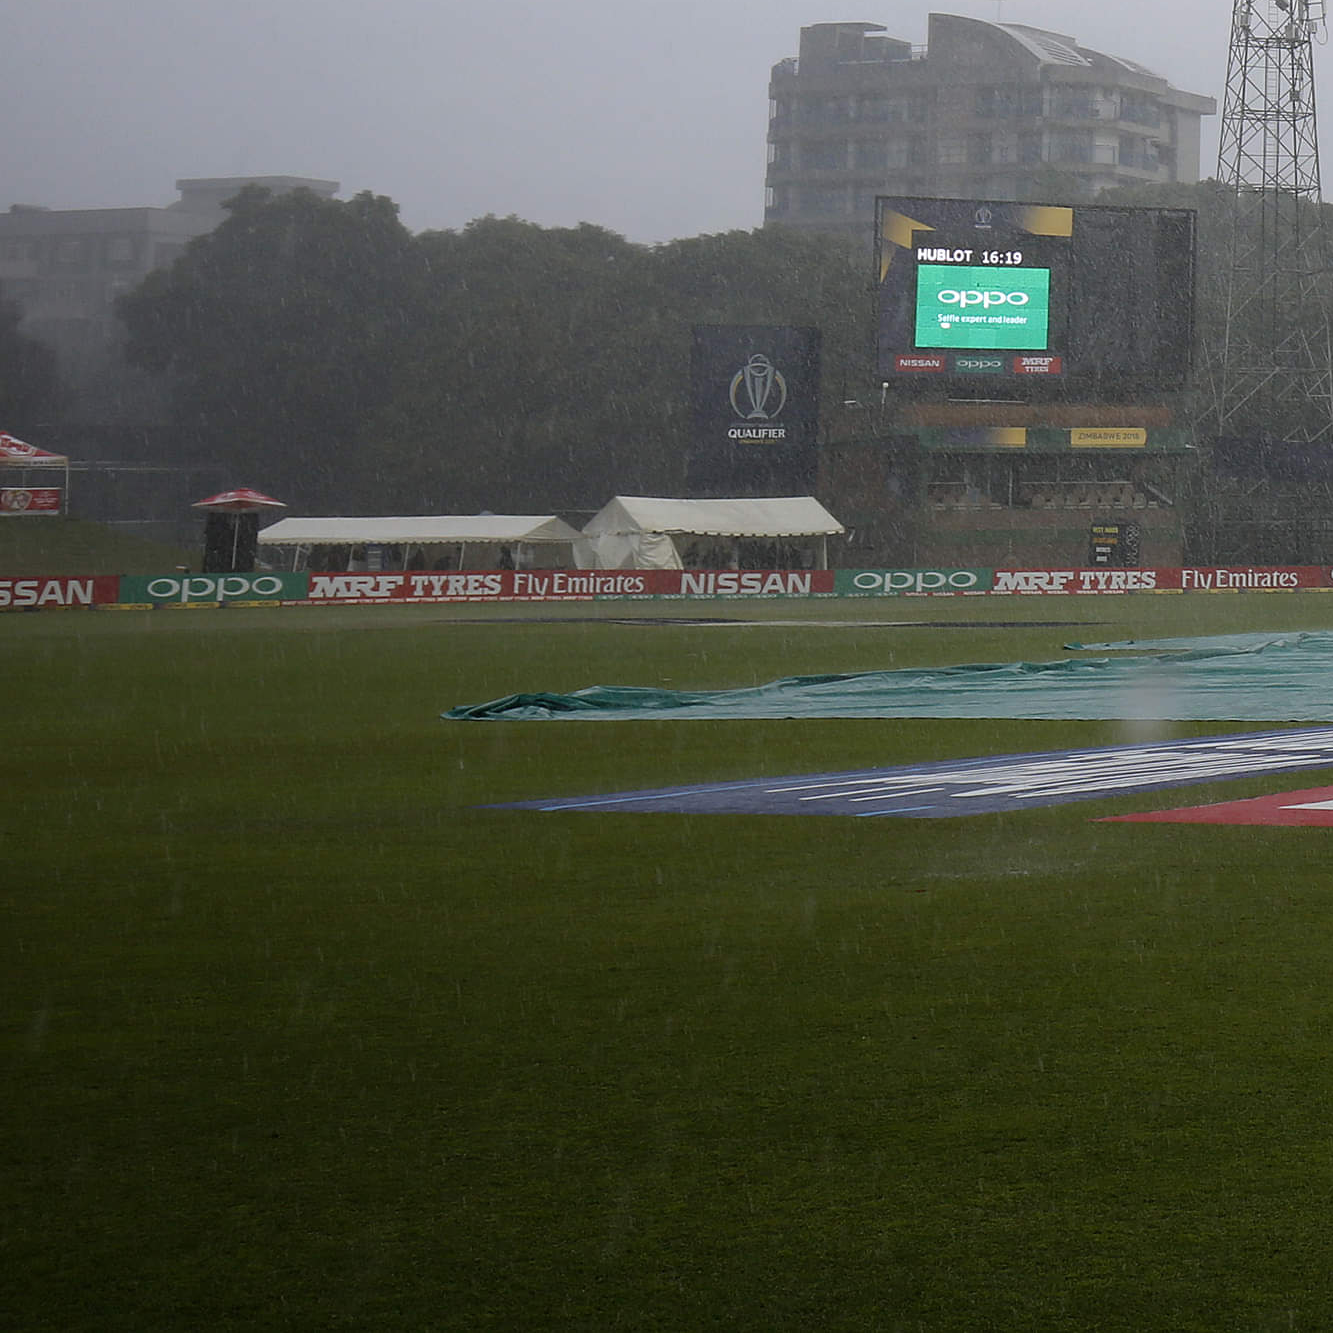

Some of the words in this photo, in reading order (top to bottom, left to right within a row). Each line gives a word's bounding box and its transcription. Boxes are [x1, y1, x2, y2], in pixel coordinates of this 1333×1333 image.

[917, 248, 973, 262] HUBLOT
[982, 252, 1022, 264] 16:19
[937, 289, 1029, 308] oppo
[961, 315, 987, 324] expert
[988, 315, 1003, 324] and
[1004, 315, 1028, 324] leader
[900, 359, 940, 367] NISSAN
[956, 360, 1001, 369] oppo
[1021, 357, 1053, 366] MRF
[728, 428, 785, 438] QUALIFIER
[308, 575, 404, 598] MRF
[410, 574, 502, 597] TYRES
[513, 573, 549, 596] Fly
[553, 573, 645, 594] Emirates
[680, 573, 811, 594] NISSAN
[853, 572, 977, 592] oppo
[993, 572, 1075, 590] MRF
[1080, 571, 1157, 590] TYRES
[1181, 569, 1212, 589] Fly
[1216, 569, 1298, 587] Emirates
[147, 576, 282, 603] oppo
